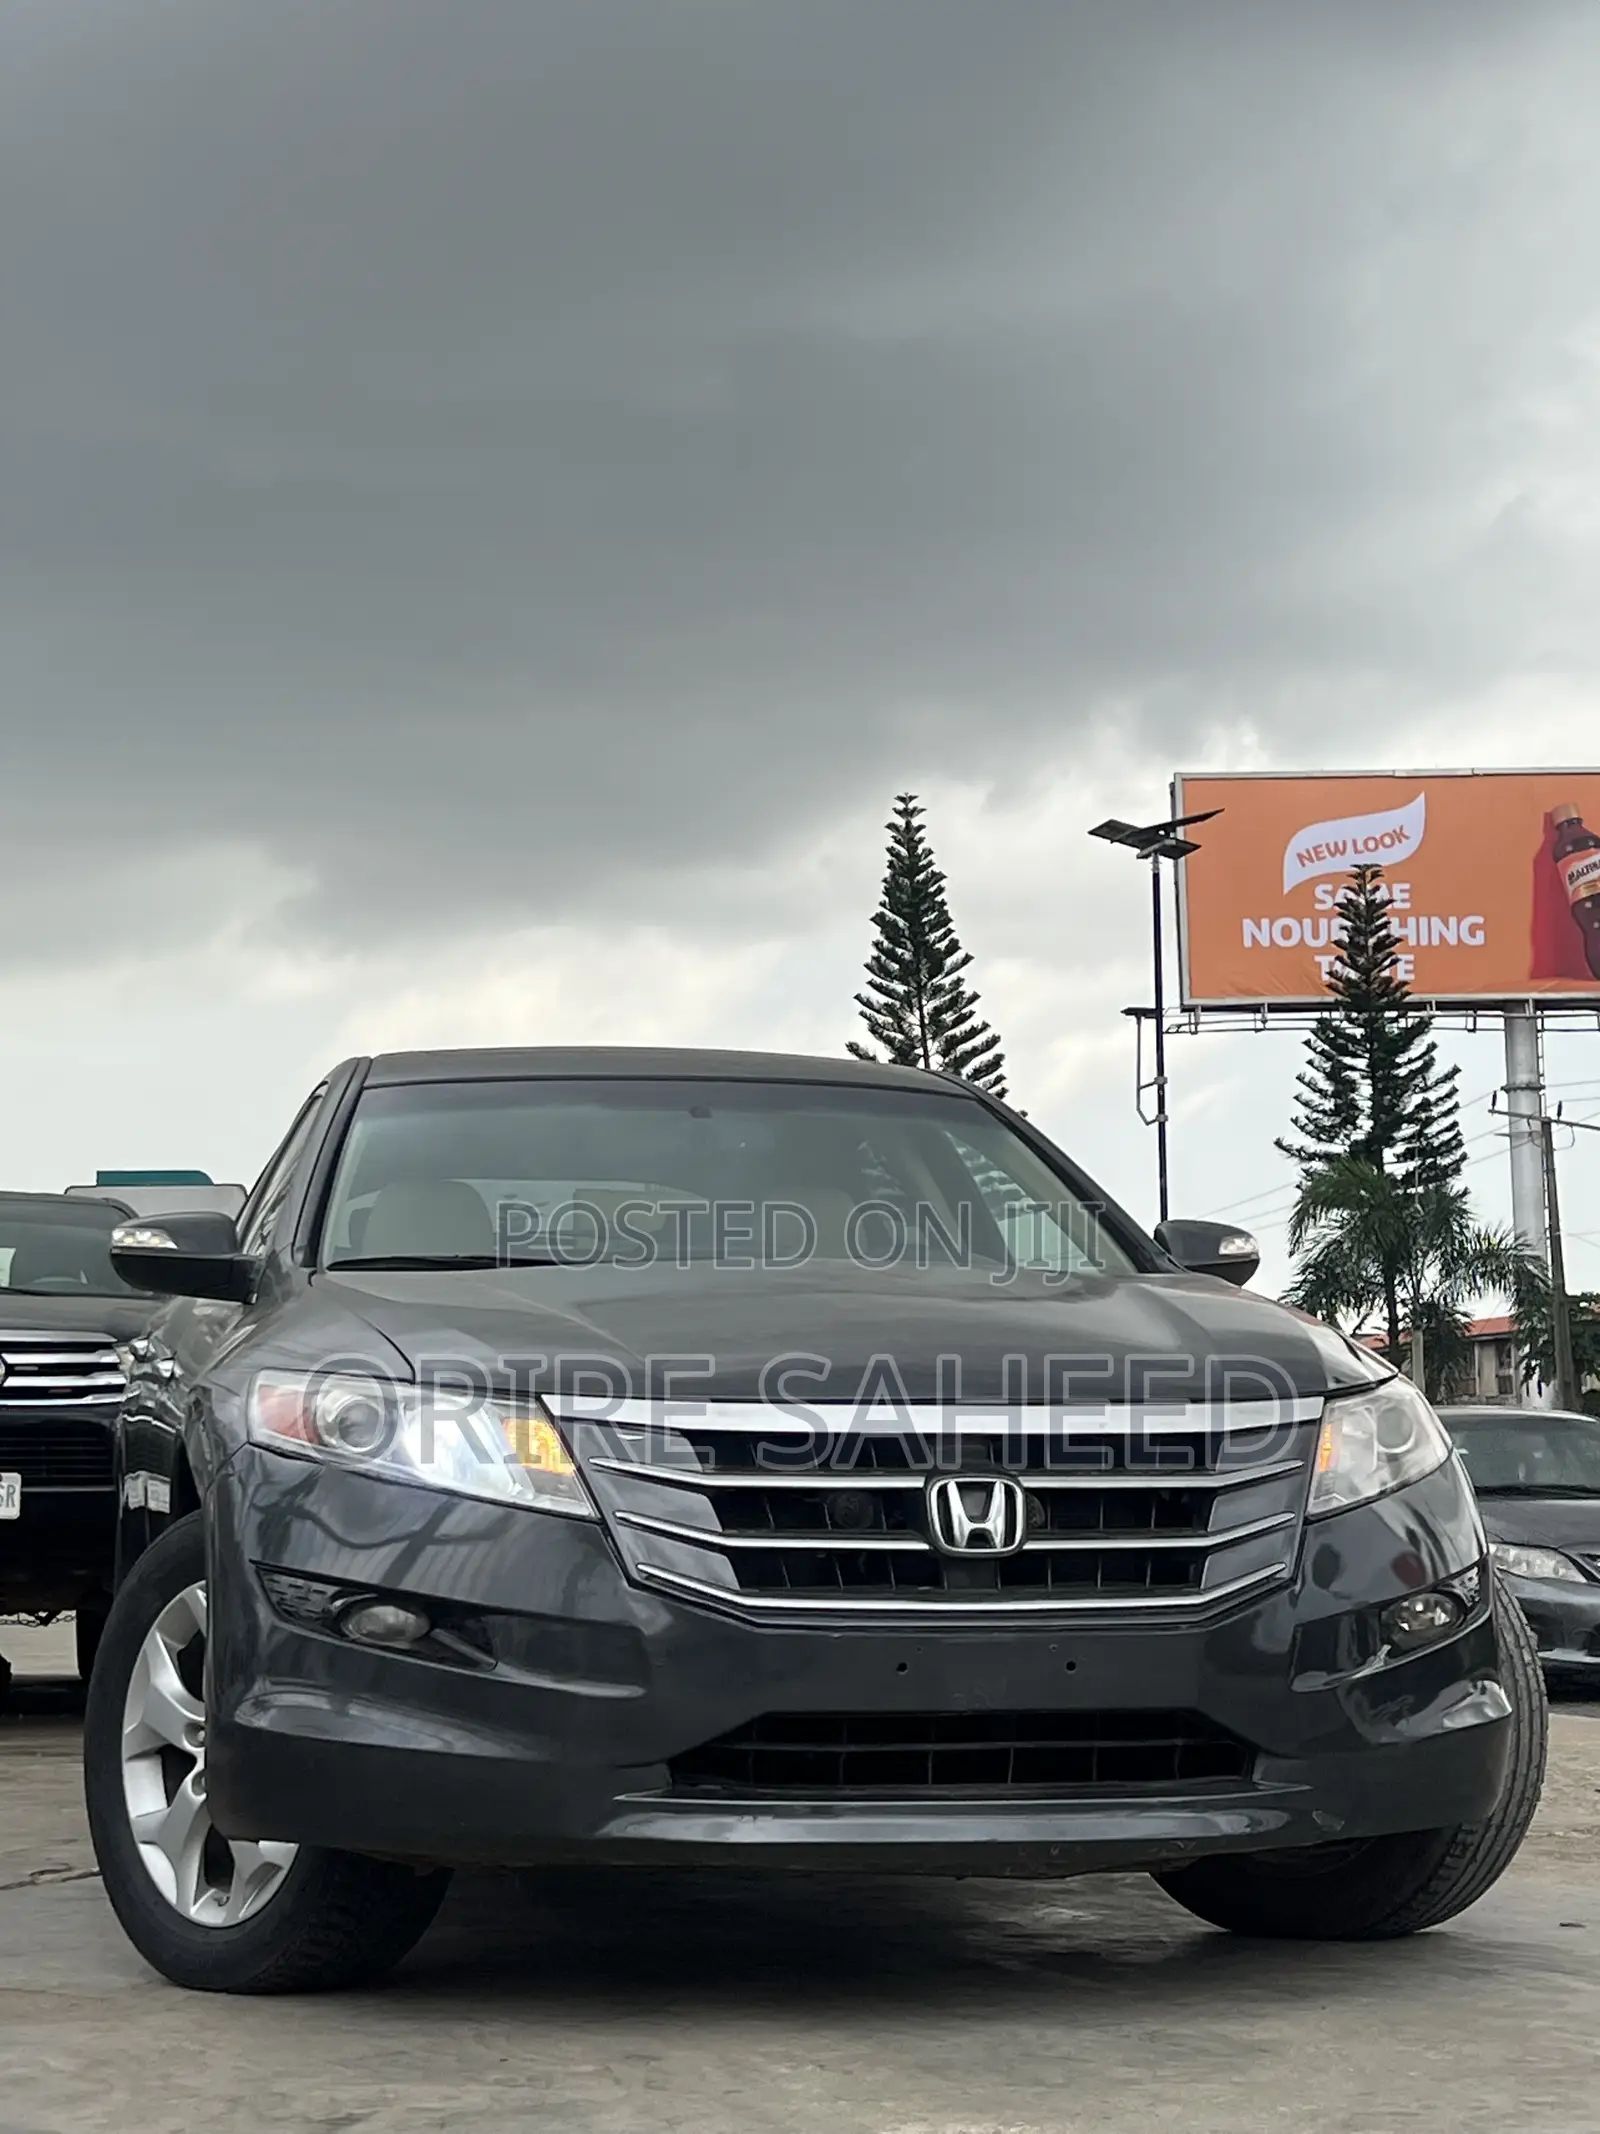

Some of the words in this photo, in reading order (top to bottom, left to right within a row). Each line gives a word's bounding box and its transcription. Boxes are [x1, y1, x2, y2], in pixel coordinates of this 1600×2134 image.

[1296, 840, 1347, 868] NEW
[1352, 825, 1411, 855] LOOK
[1242, 916, 1485, 947] NOURHING
